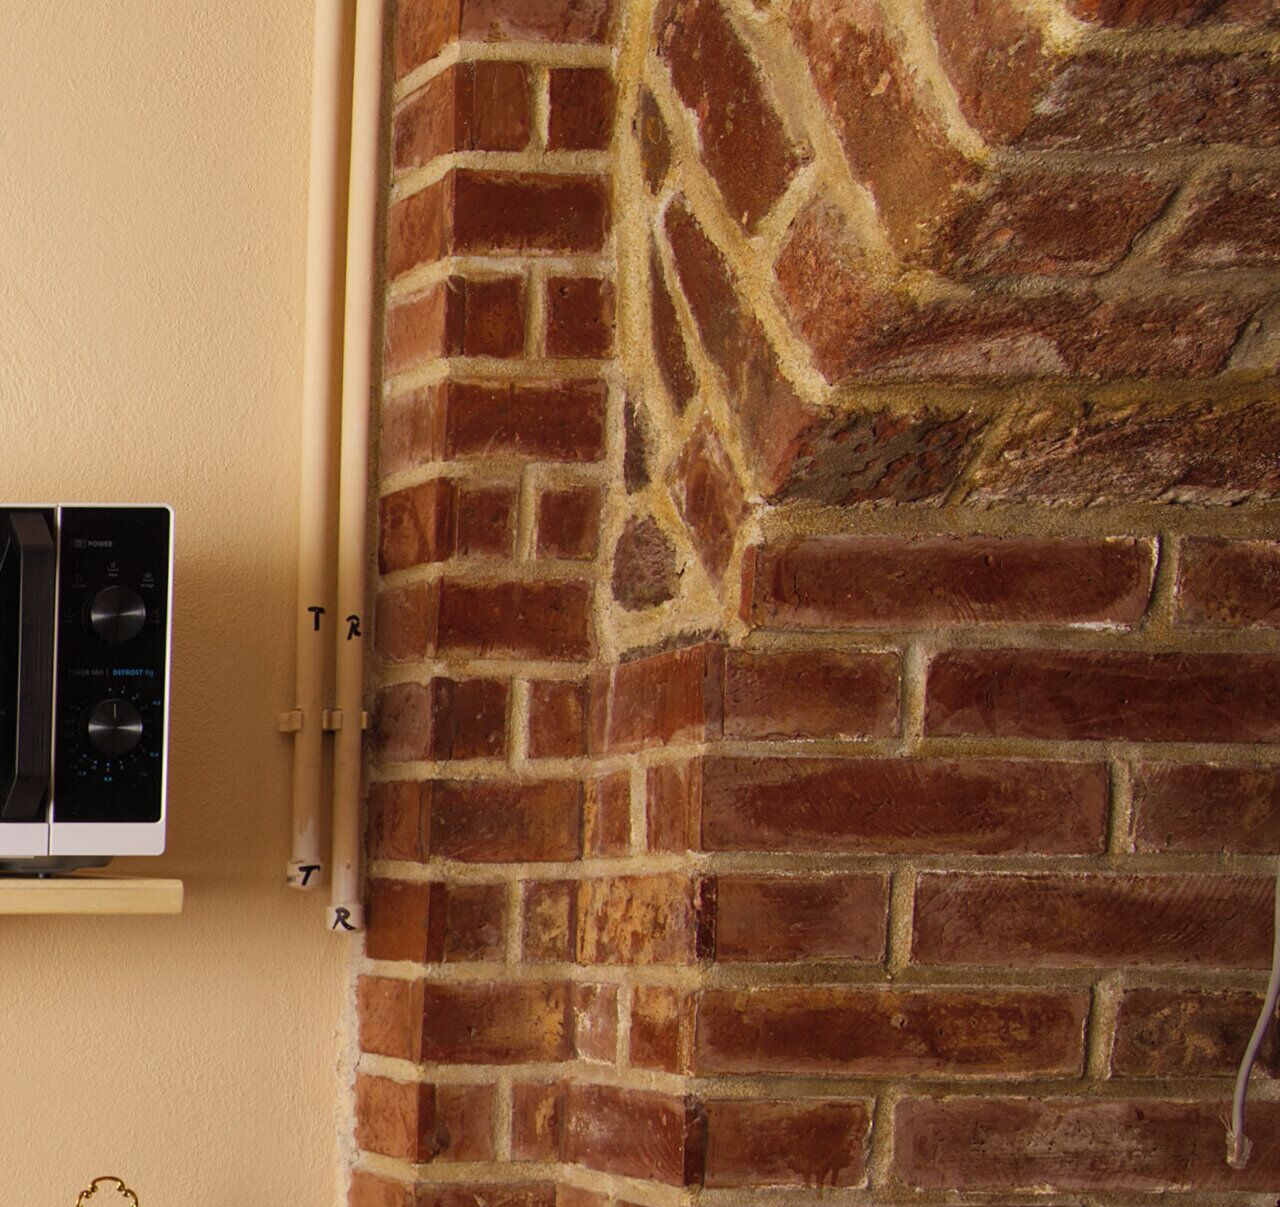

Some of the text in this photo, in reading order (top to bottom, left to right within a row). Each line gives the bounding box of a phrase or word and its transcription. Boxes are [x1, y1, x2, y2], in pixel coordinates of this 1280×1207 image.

[307, 606, 326, 632] T
[346, 614, 363, 641] R
[112, 669, 144, 677] DEFROST
[297, 864, 321, 887] T
[332, 907, 357, 931] R
